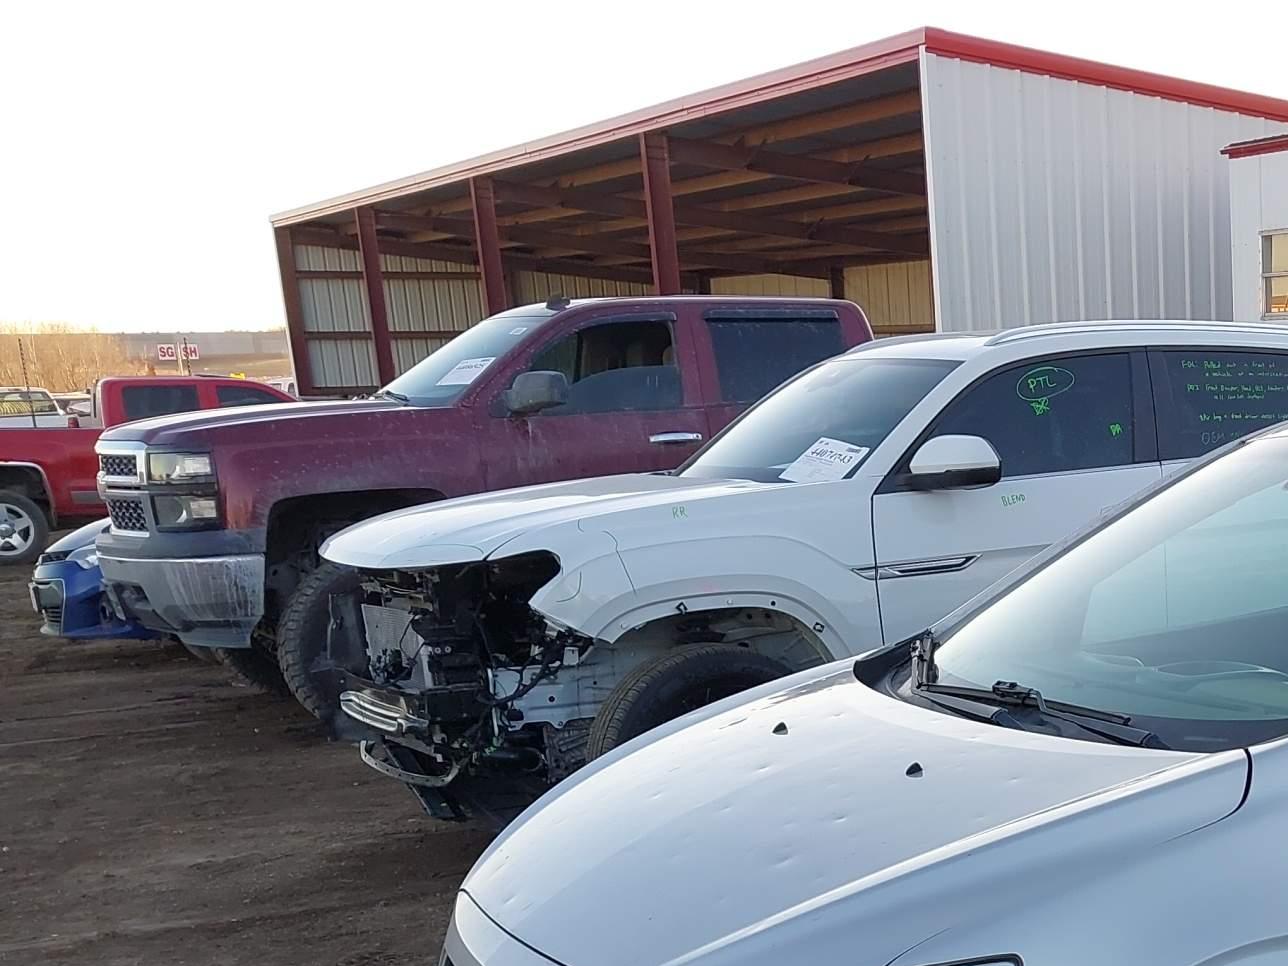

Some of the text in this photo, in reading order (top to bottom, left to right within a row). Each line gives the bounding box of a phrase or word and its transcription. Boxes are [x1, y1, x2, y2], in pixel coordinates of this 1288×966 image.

[159, 346, 198, 358] SG SH
[1027, 375, 1057, 393] PTL
[1001, 494, 1026, 507] BLEND
